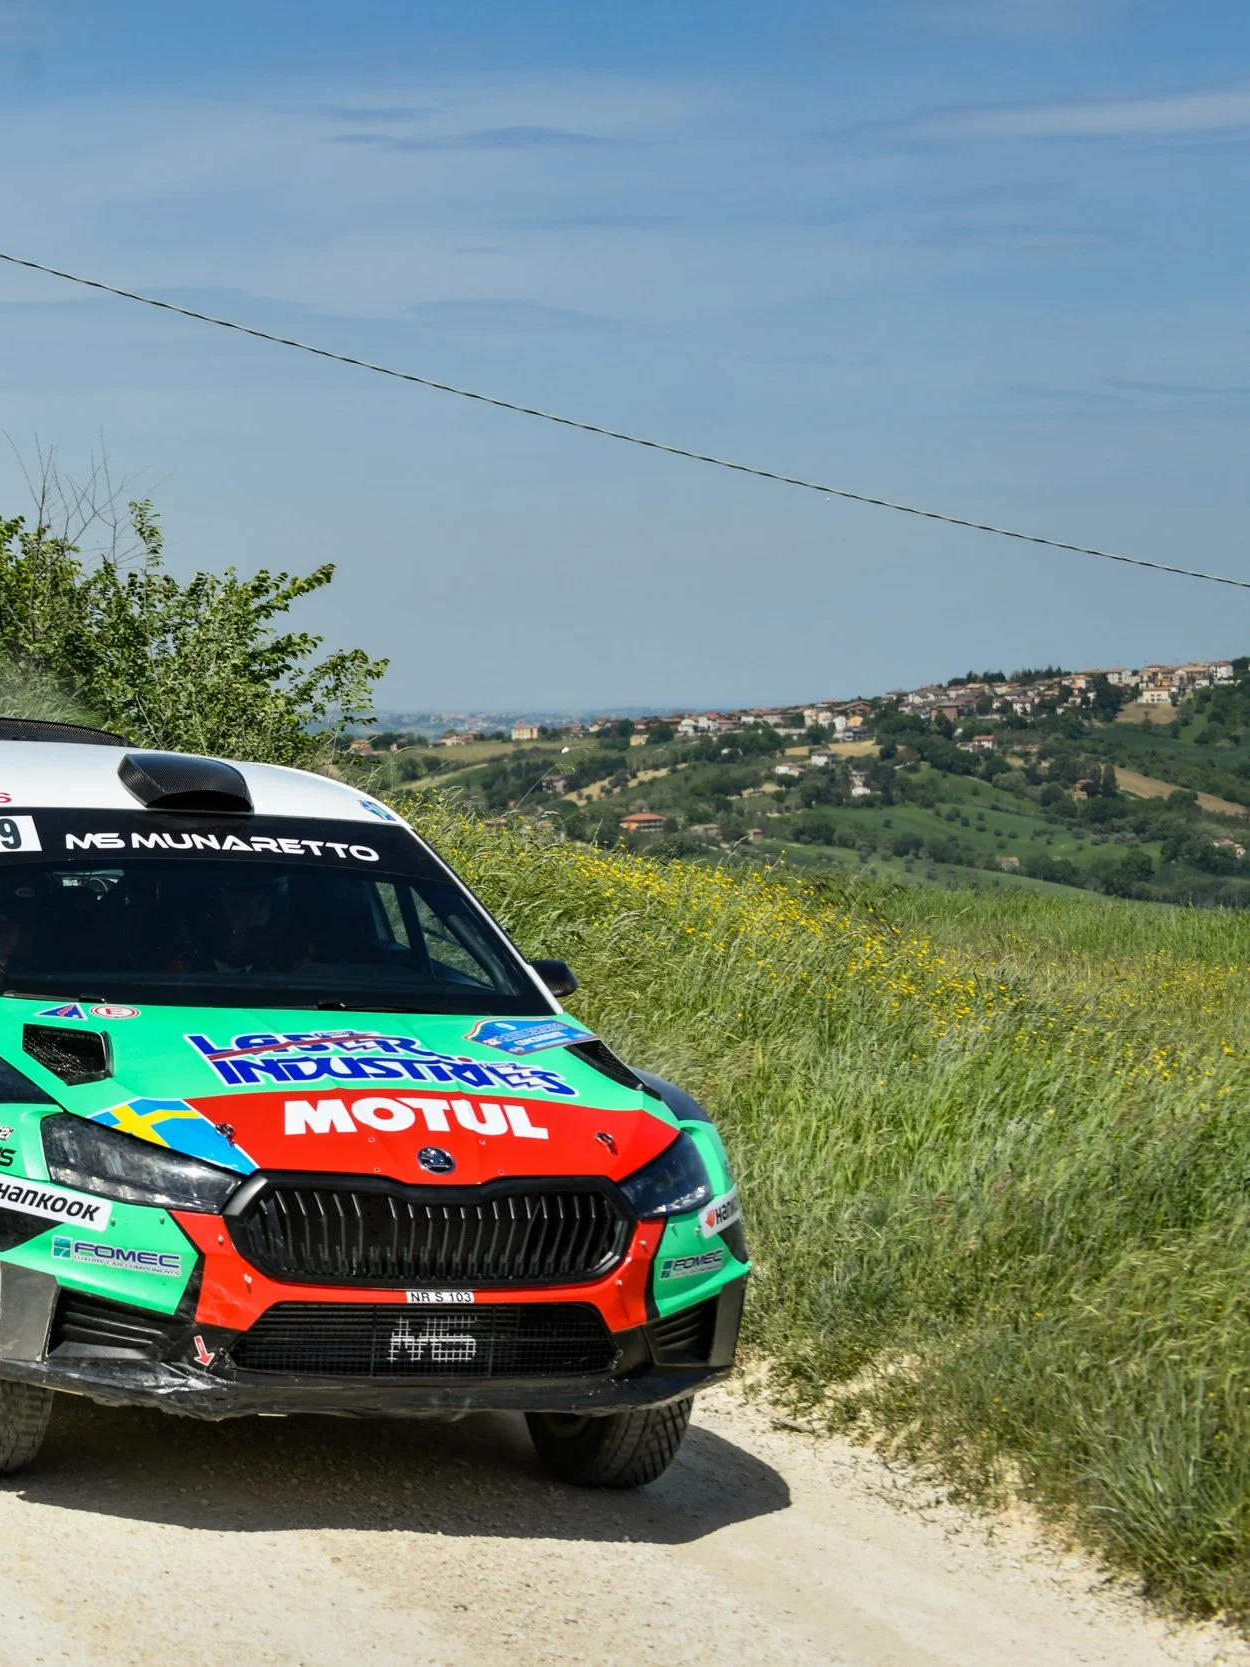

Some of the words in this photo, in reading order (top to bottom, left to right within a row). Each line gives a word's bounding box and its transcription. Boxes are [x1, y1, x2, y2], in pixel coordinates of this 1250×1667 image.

[65, 832, 125, 850] MS
[131, 832, 379, 862] MUNARETTO
[284, 1097, 550, 1140] MOTUL
[74, 1242, 180, 1269] FOMEC
[672, 1249, 723, 1271] FOMEC
[411, 1292, 430, 1302] NR
[435, 1291, 444, 1302] S
[449, 1292, 472, 1302] 103
